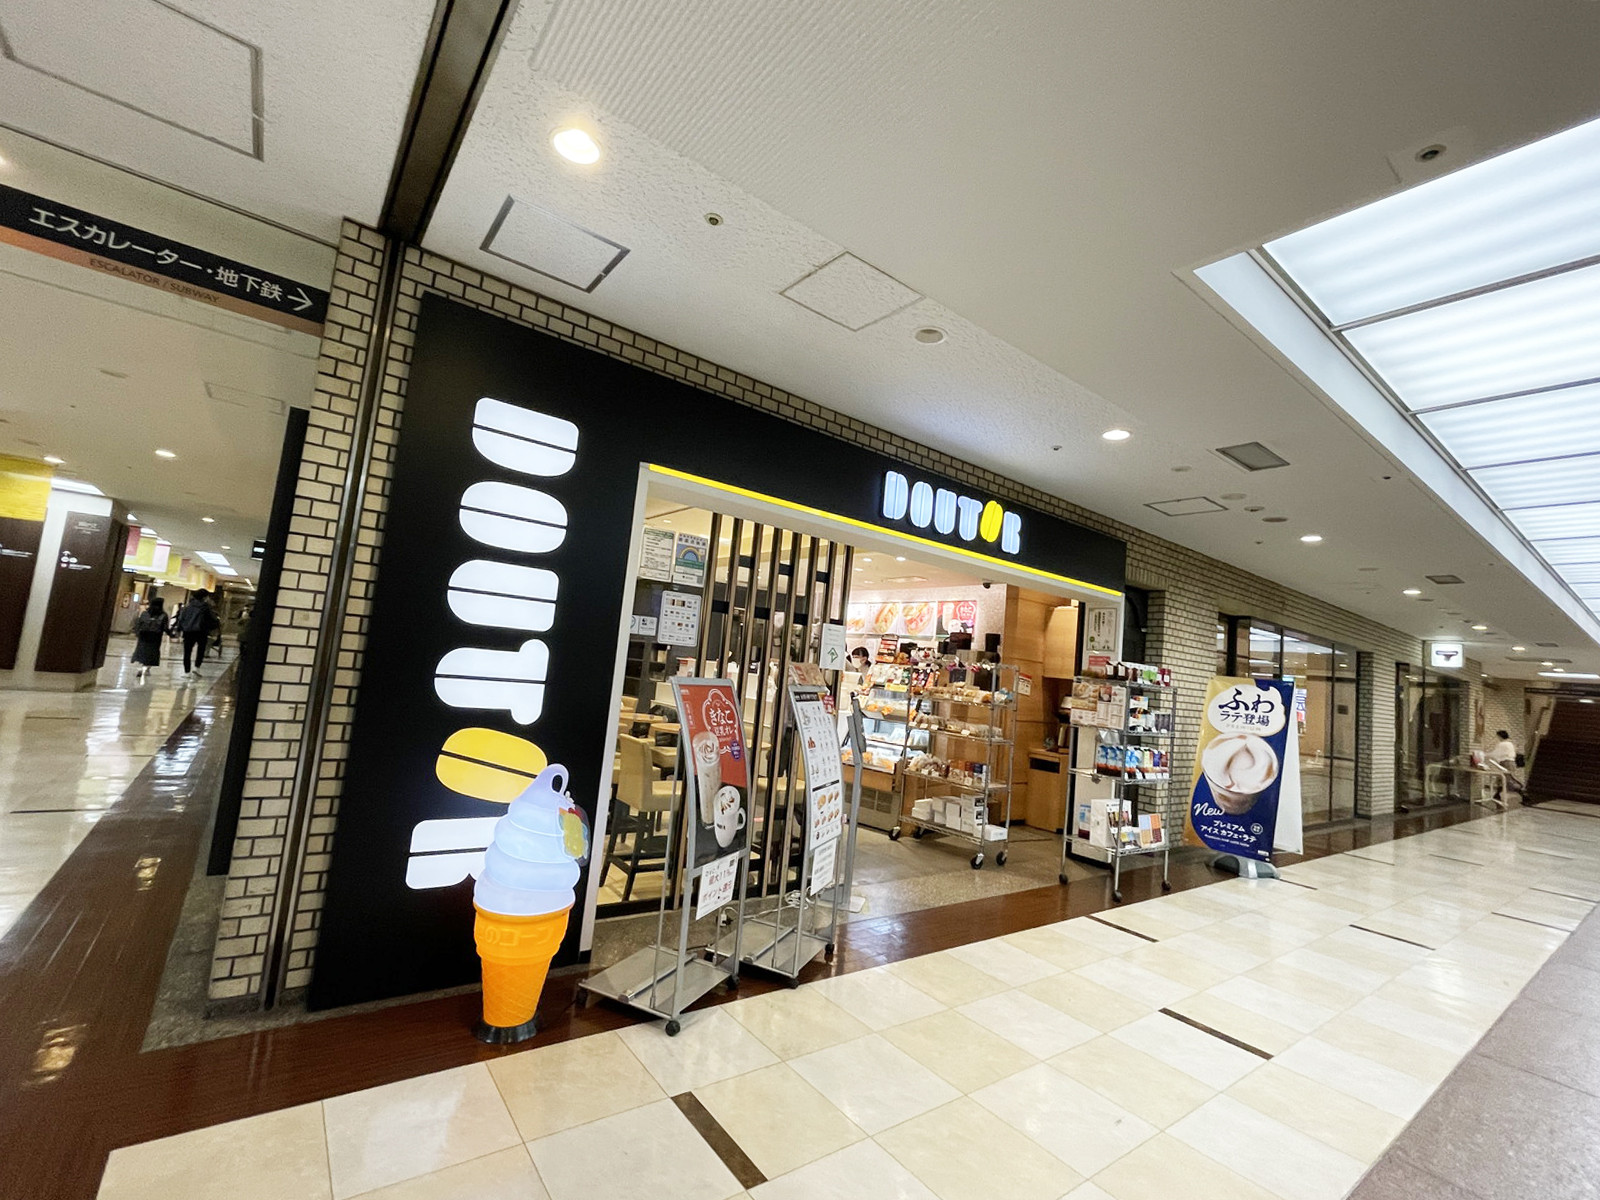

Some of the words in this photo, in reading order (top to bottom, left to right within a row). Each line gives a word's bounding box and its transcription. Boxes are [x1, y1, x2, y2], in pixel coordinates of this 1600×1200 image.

[29, 207, 284, 302] エスカレーター・地下鉄
[89, 257, 161, 287] ESCALATOR
[169, 282, 221, 304] SUBWAY
[882, 470, 1022, 555] DOUTOR
[1218, 687, 1275, 714] ふわ
[708, 707, 734, 726] きなこ
[1220, 710, 1271, 727] ラテ登場
[1193, 801, 1226, 817] New
[1213, 819, 1246, 833] プレミアム
